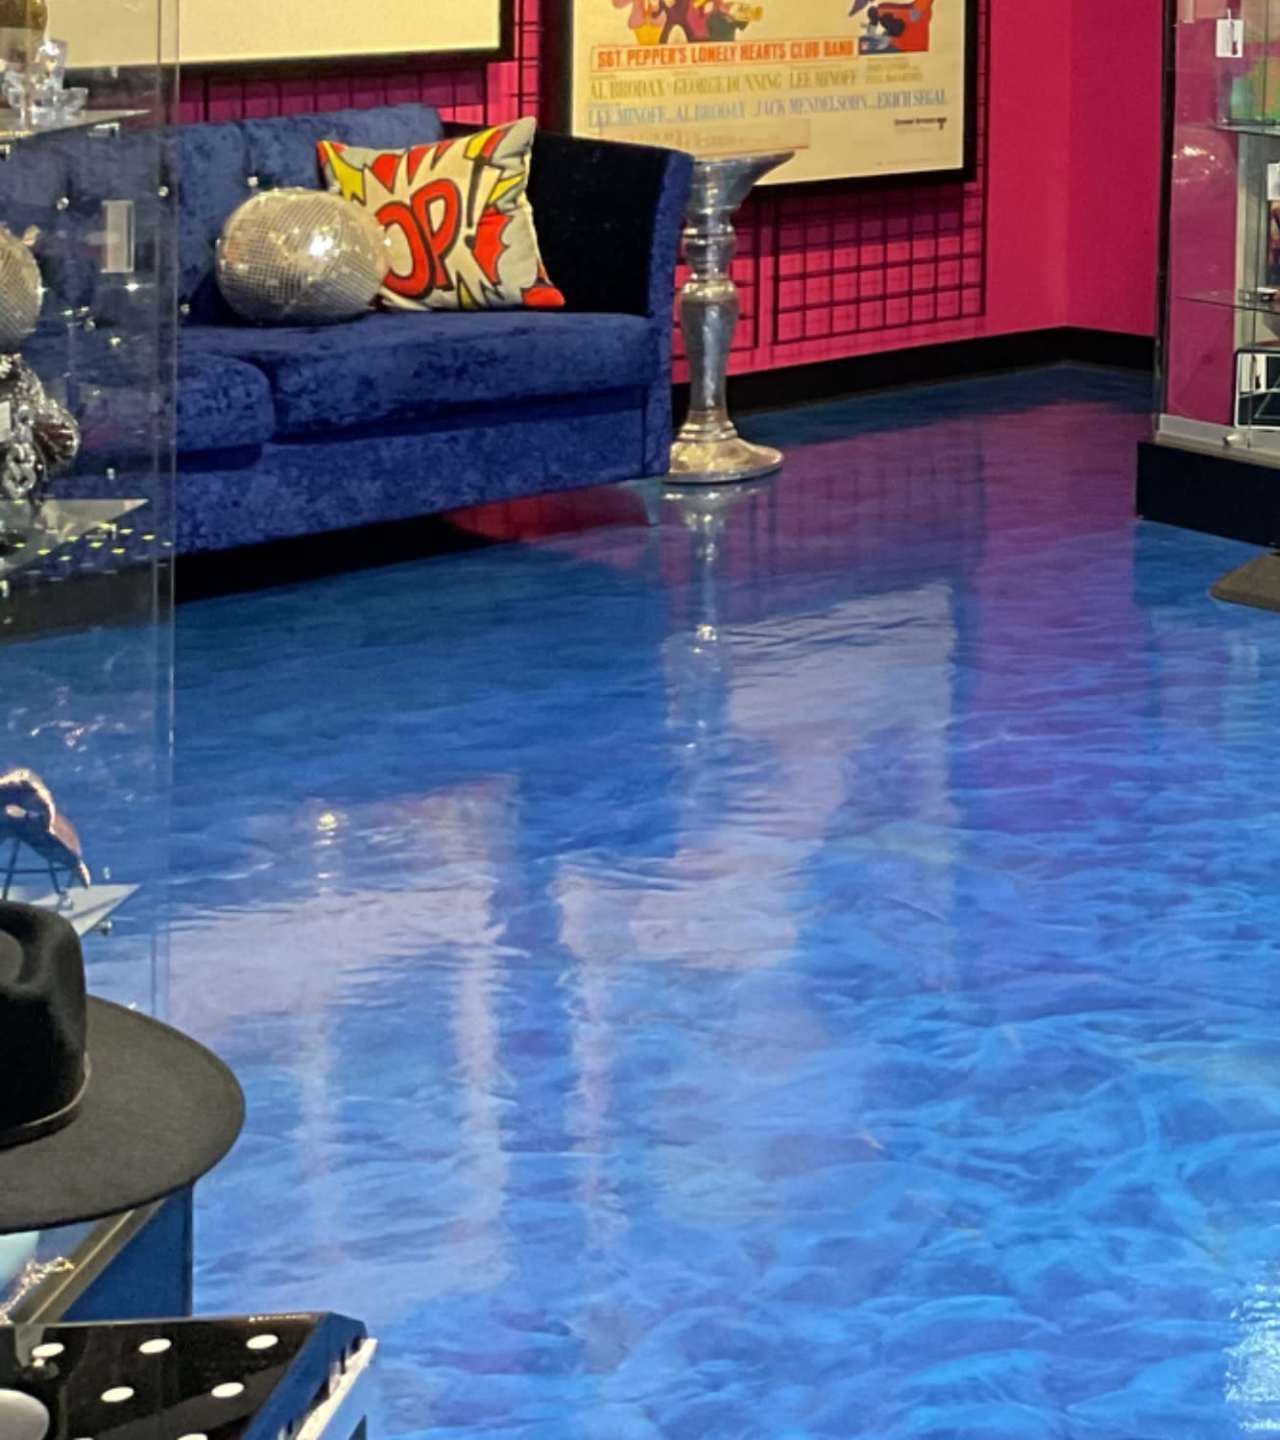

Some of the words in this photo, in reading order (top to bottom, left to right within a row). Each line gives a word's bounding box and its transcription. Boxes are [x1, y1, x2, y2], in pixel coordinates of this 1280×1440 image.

[626, 47, 687, 66] PEPPER'S
[691, 44, 736, 64] LONELY
[740, 42, 785, 61] HEARTS
